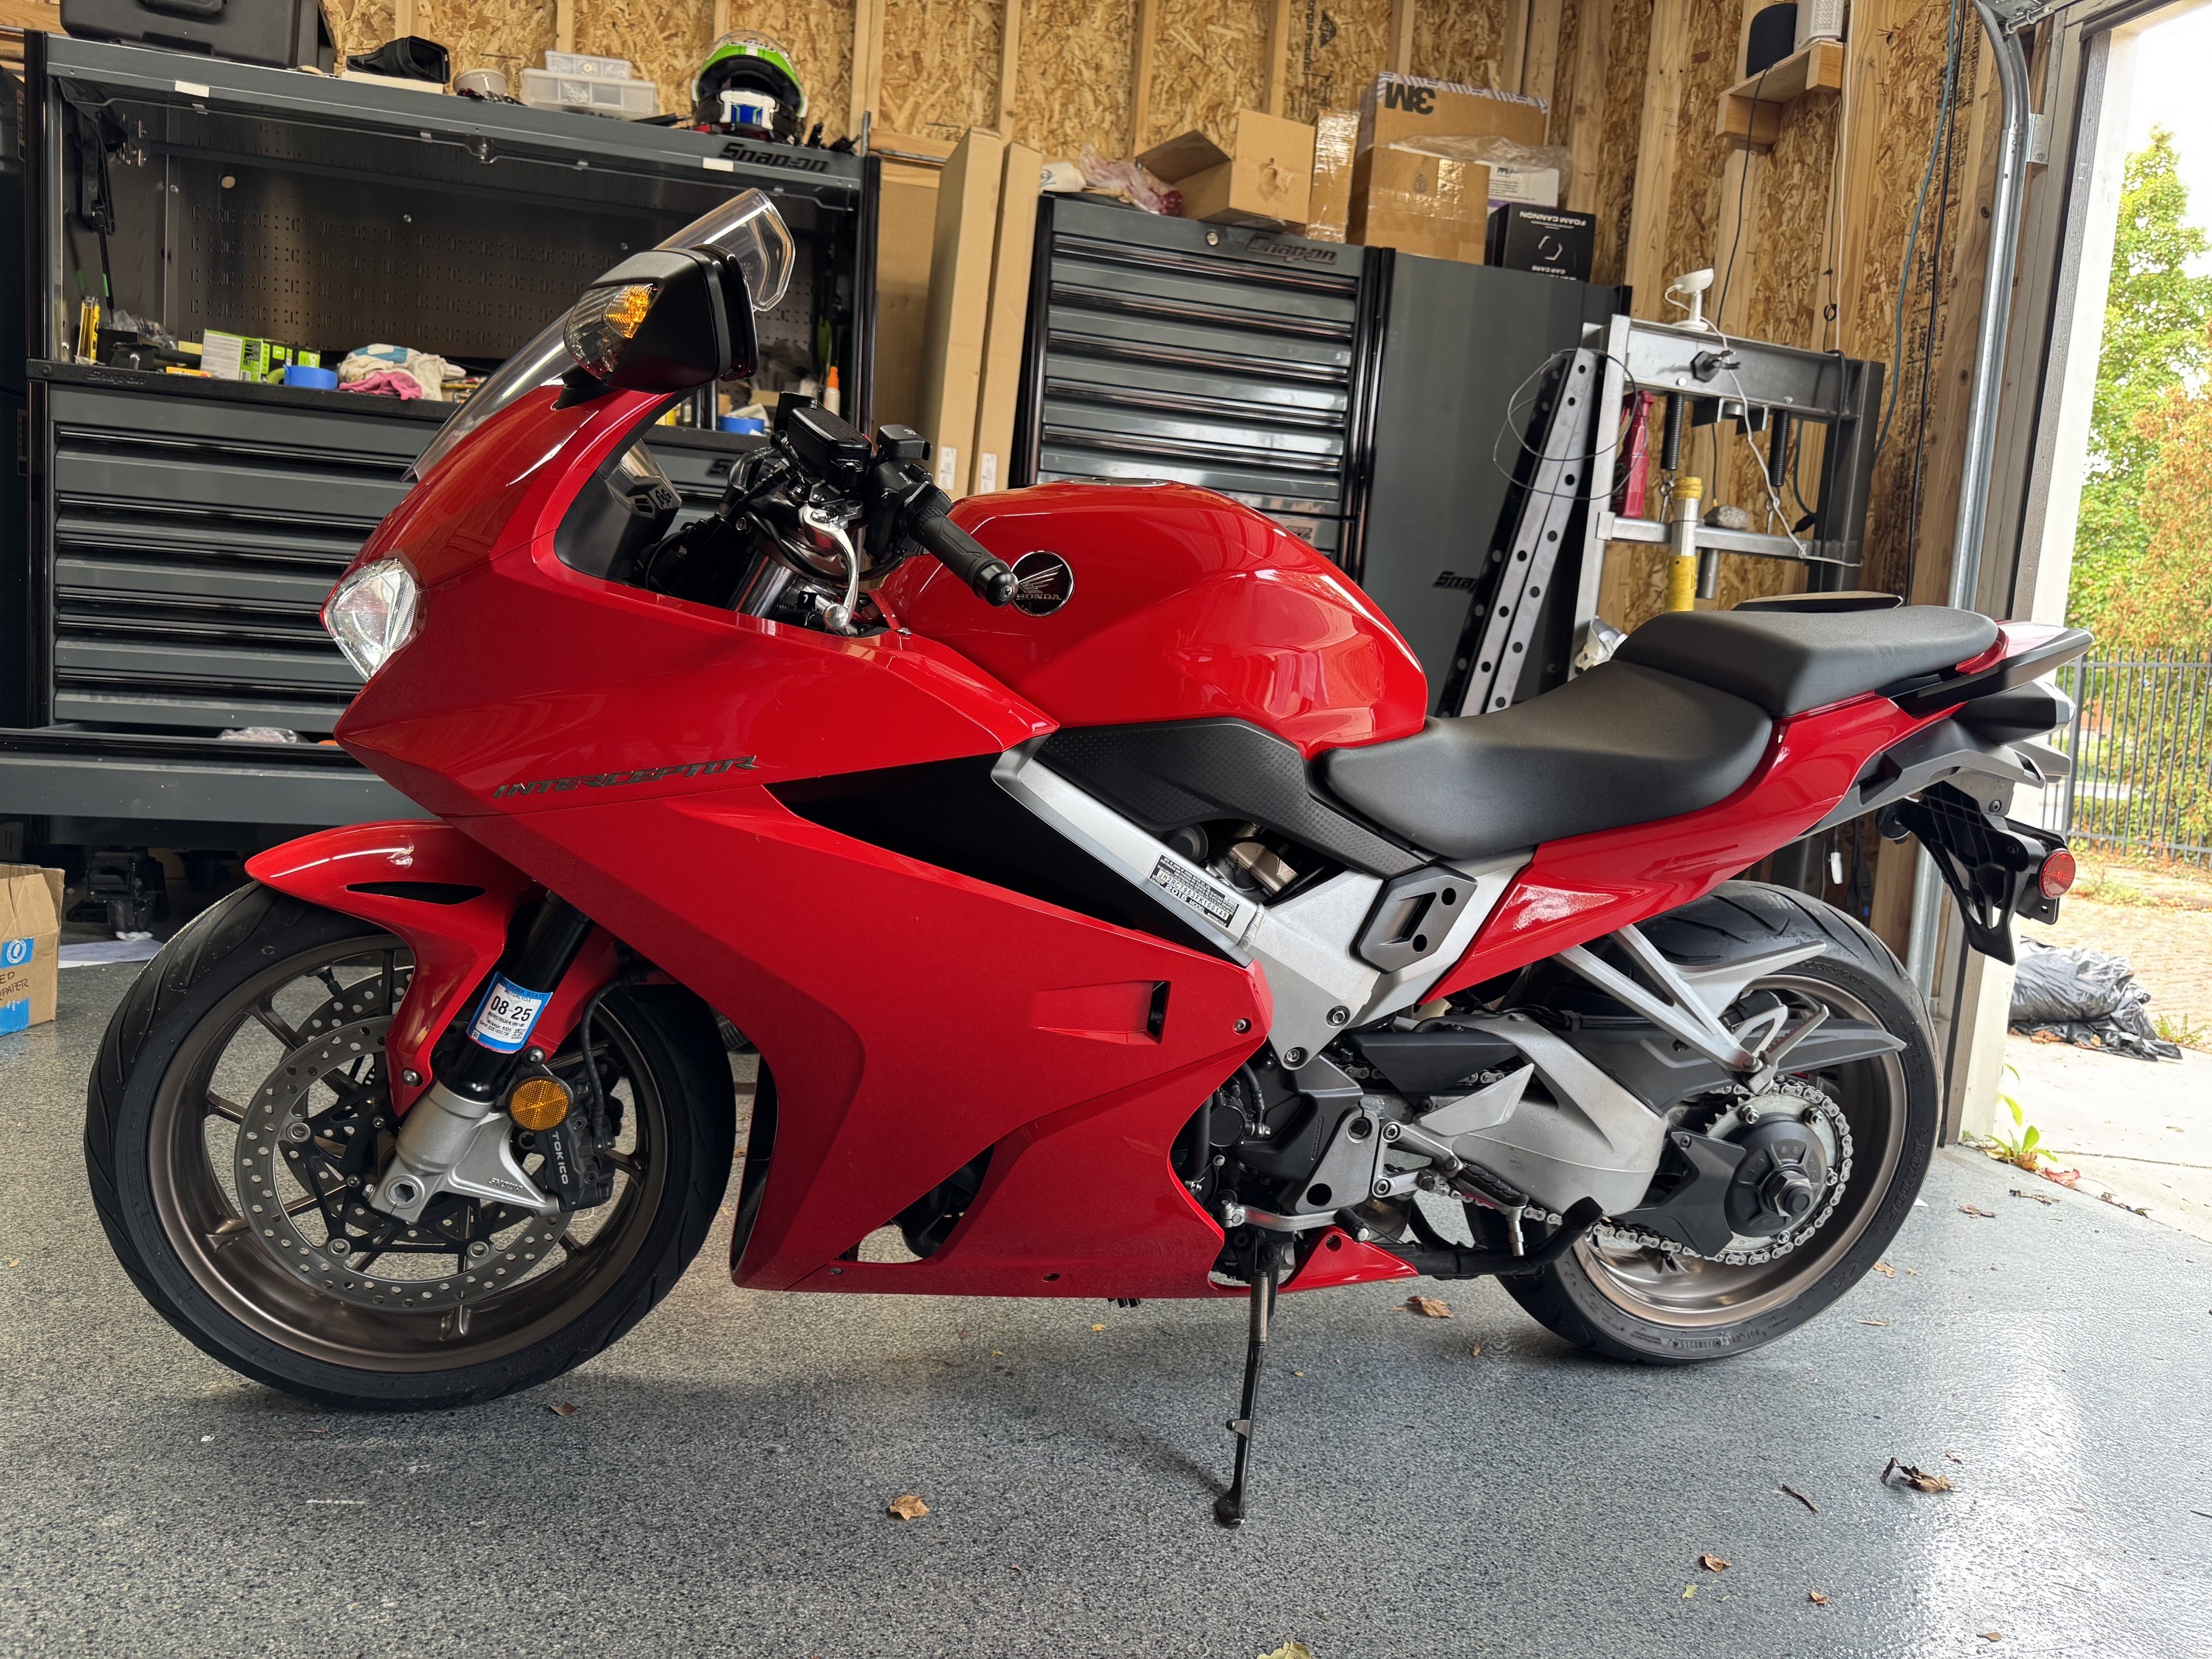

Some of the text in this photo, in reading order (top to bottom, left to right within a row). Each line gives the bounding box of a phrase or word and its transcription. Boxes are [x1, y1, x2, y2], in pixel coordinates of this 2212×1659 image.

[1385, 81, 1435, 115] 3M
[719, 143, 829, 172] Snap-on
[1520, 211, 1558, 223] CANNON
[1560, 218, 1586, 226] FOAM
[1245, 233, 1337, 265] Snap-on
[493, 755, 760, 798] INTERCEPTOR
[1159, 872, 1228, 919] JH2RC7953FK100149
[1165, 884, 1187, 901] 2015
[1189, 899, 1205, 912] MODEL
[504, 988, 531, 1003] MOTORCYCLE
[509, 984, 525, 995] YORK
[490, 995, 533, 1022] 08-25
[552, 1131, 569, 1185] TOKICO
[1888, 1142, 1924, 1223] DUNLOP
